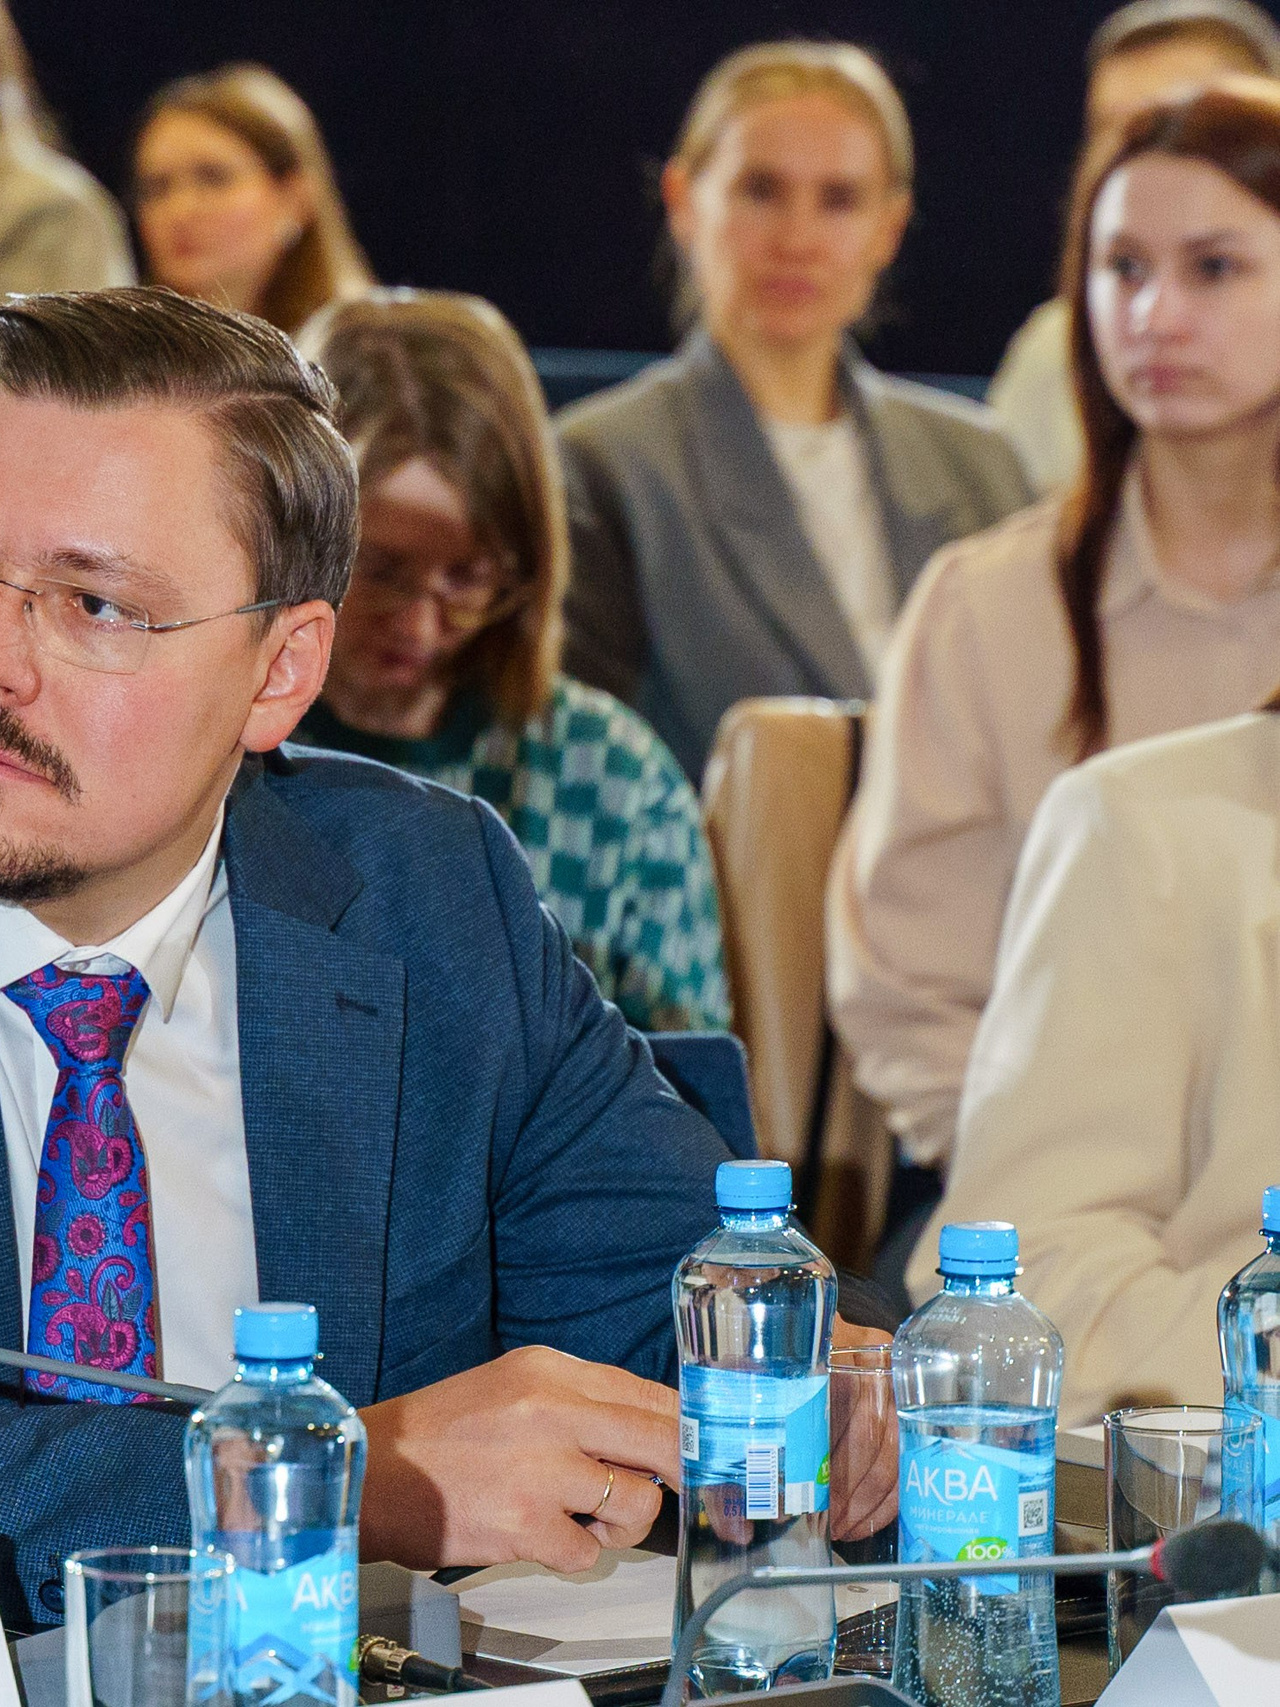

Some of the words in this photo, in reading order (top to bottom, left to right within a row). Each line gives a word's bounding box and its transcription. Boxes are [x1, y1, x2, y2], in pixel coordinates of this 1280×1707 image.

[905, 1459, 998, 1506] АКВА
[909, 1506, 990, 1524] МИНЕРАЛЕ
[965, 1543, 1016, 1561] 100%
[291, 1570, 356, 1612] АКВ
